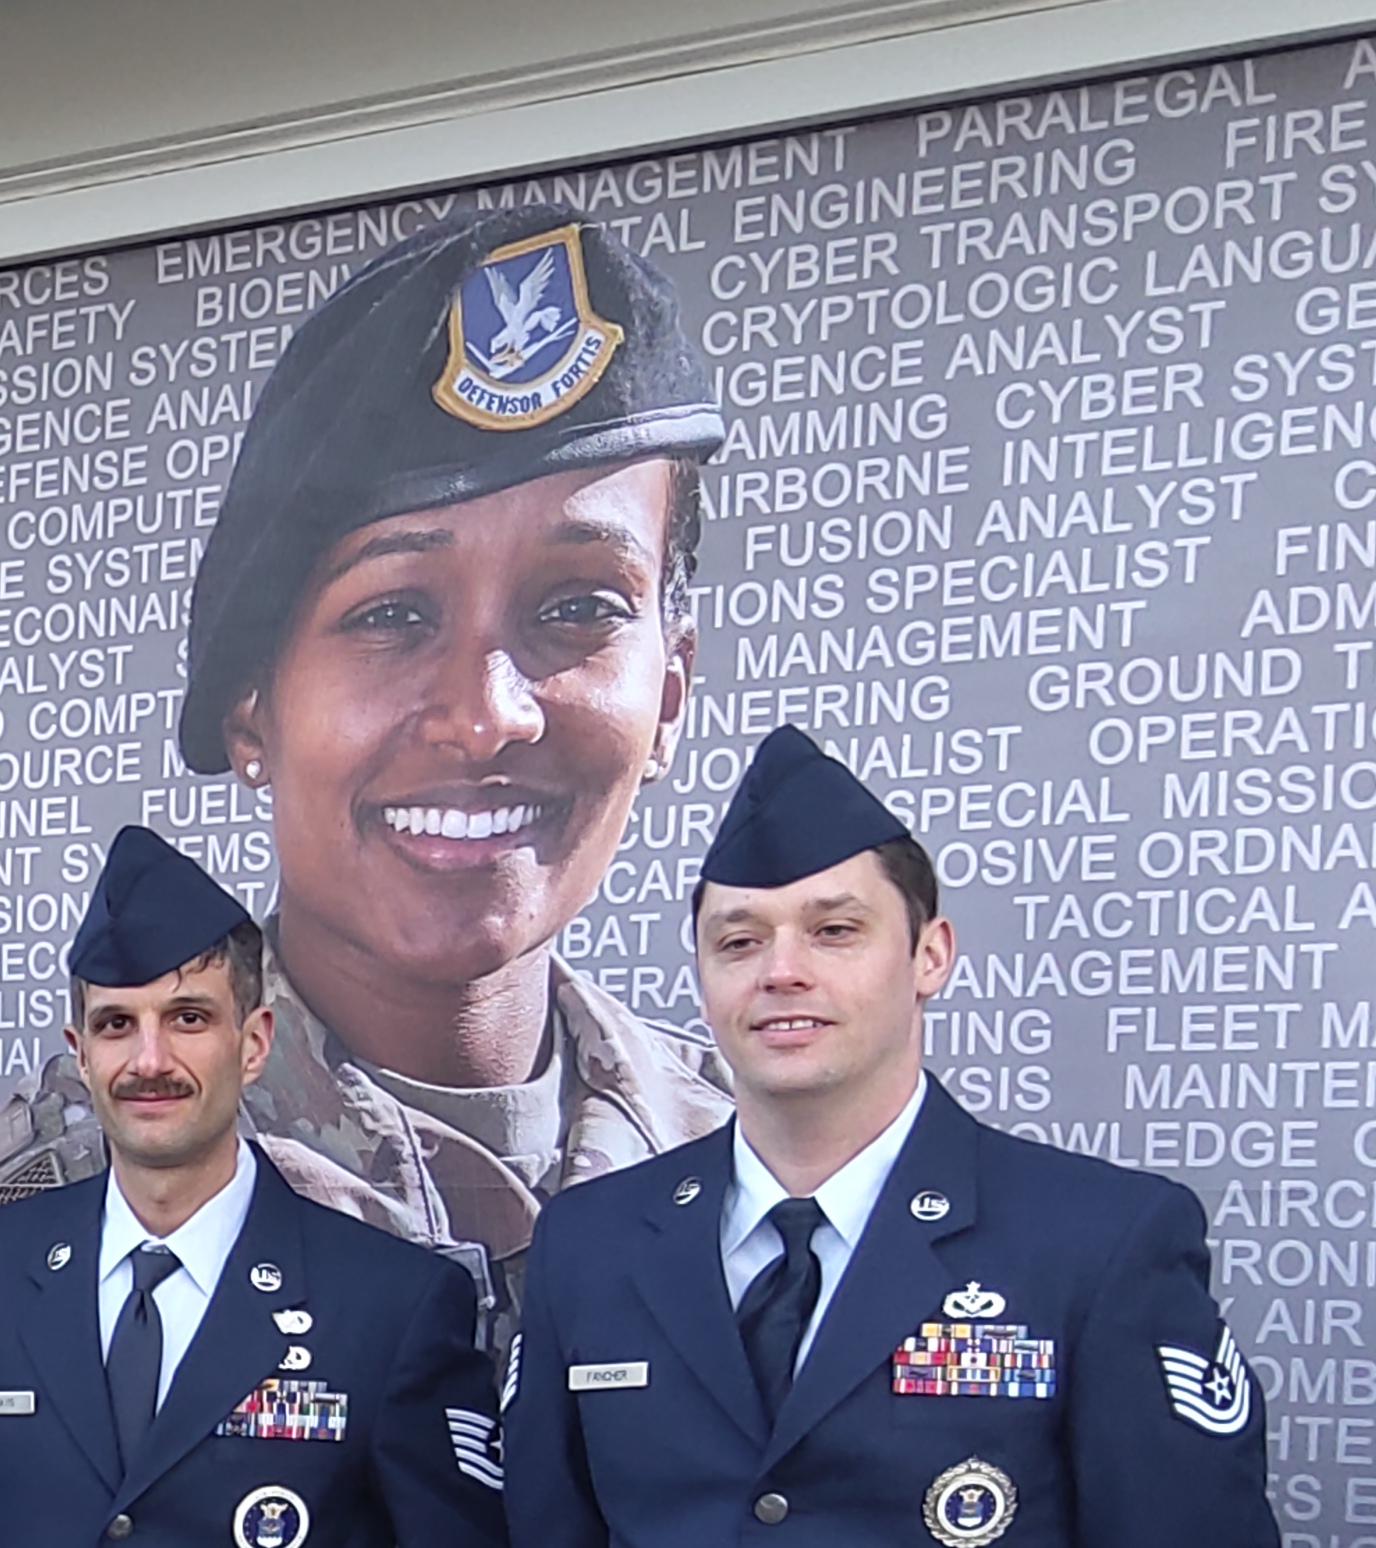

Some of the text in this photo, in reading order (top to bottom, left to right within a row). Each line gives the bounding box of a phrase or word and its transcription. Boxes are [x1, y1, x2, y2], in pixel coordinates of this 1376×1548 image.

[918, 62, 1277, 158] PARALEGAL
[734, 138, 1136, 243] ENGINEERING
[1225, 100, 1367, 165] FIRE
[711, 232, 900, 300] CYBER
[919, 171, 1298, 269] TRANSPORT
[702, 257, 1119, 355] CRYPTOLOGIC
[944, 300, 1226, 380] ANALYST
[458, 335, 602, 414] DEFENSOR FORTIS
[996, 363, 1204, 429] CYBER
[746, 505, 952, 571] FUSION
[975, 472, 1258, 546] ANALYST
[866, 536, 1212, 613] SPECIALIST
[736, 600, 1147, 681] MANAGEMENT
[1028, 648, 1302, 711] GROUND
[141, 783, 273, 828] FUELS
[888, 778, 1130, 833] SPECIAL
[1013, 888, 1316, 939] TACTICAL
[932, 942, 1339, 1000] ANAGEMENT
[1106, 1002, 1304, 1054] FLEET
[1255, 1298, 1363, 1344] AIR
